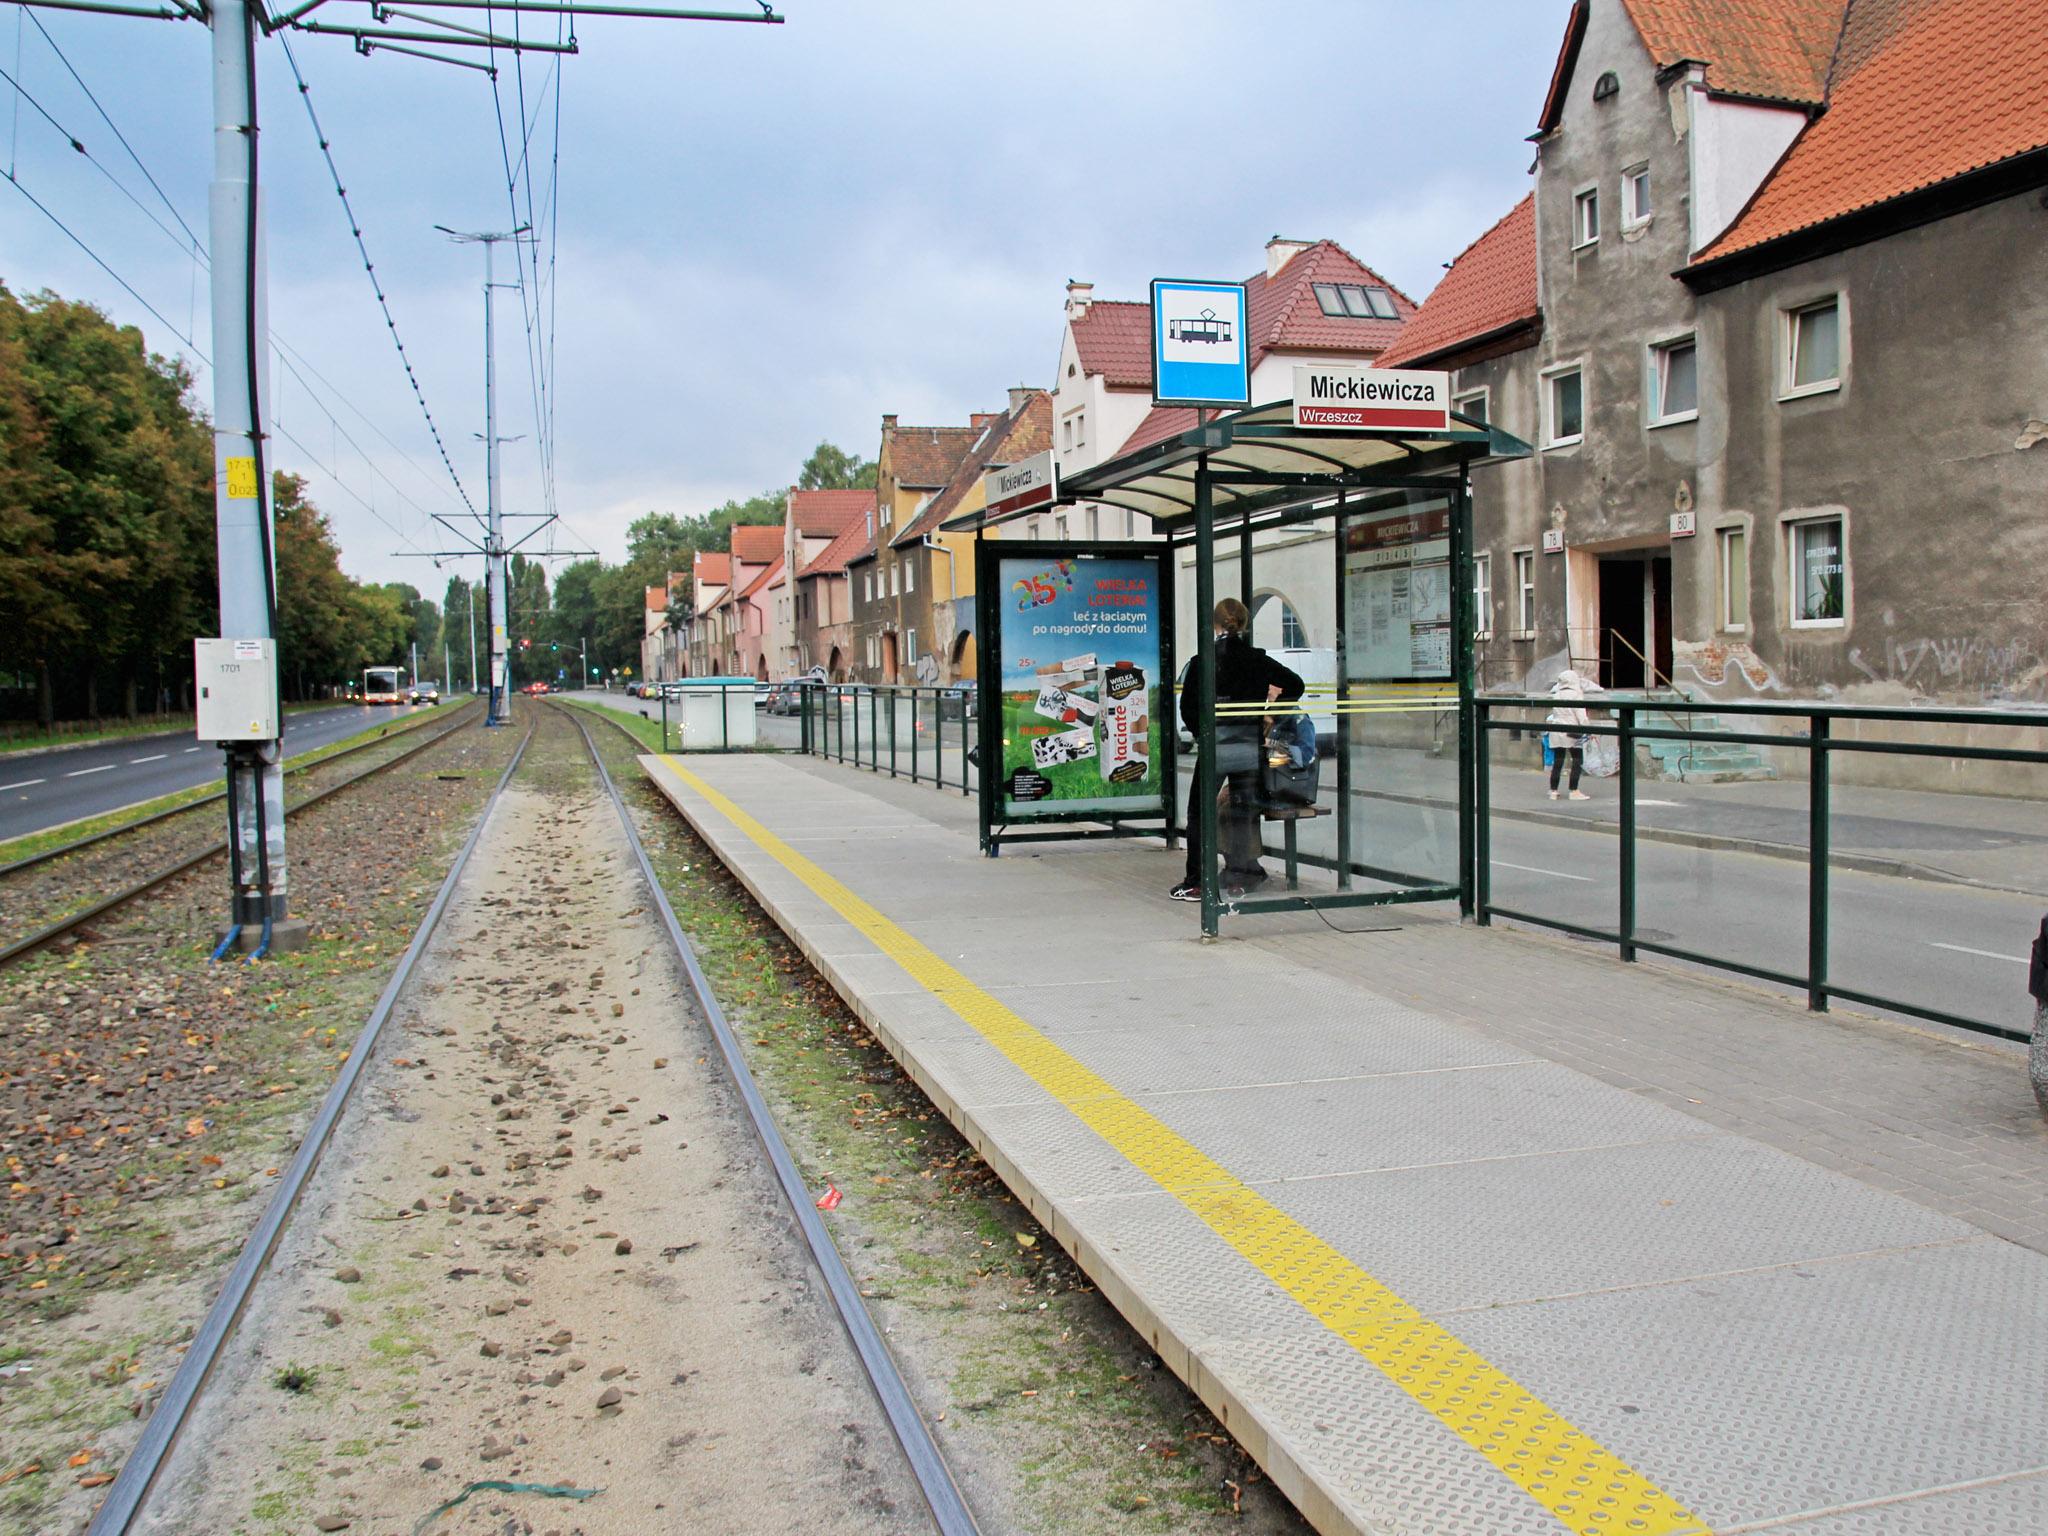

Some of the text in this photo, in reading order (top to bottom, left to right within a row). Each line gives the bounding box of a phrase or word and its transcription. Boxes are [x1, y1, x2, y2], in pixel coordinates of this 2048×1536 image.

[1310, 375, 1435, 402] Mickiewicza
[1301, 408, 1363, 424] Wrzeszcz
[1000, 468, 1032, 493] Mickiewicza
[1376, 519, 1420, 539] MICKIEWICZA
[1677, 514, 1688, 531] 80
[1548, 532, 1558, 547] 78
[1095, 578, 1147, 591] WIELKA
[1012, 575, 1057, 613] 25
[1087, 593, 1147, 607] LOTERIA!
[1073, 611, 1147, 622] leć z łaciatym
[1032, 623, 1147, 635] po nagrody do domu!
[220, 664, 241, 673] 1701
[1109, 673, 1134, 685] WIELKA
[1111, 678, 1138, 692] LOTERIA!
[1114, 705, 1127, 761] łaciate
